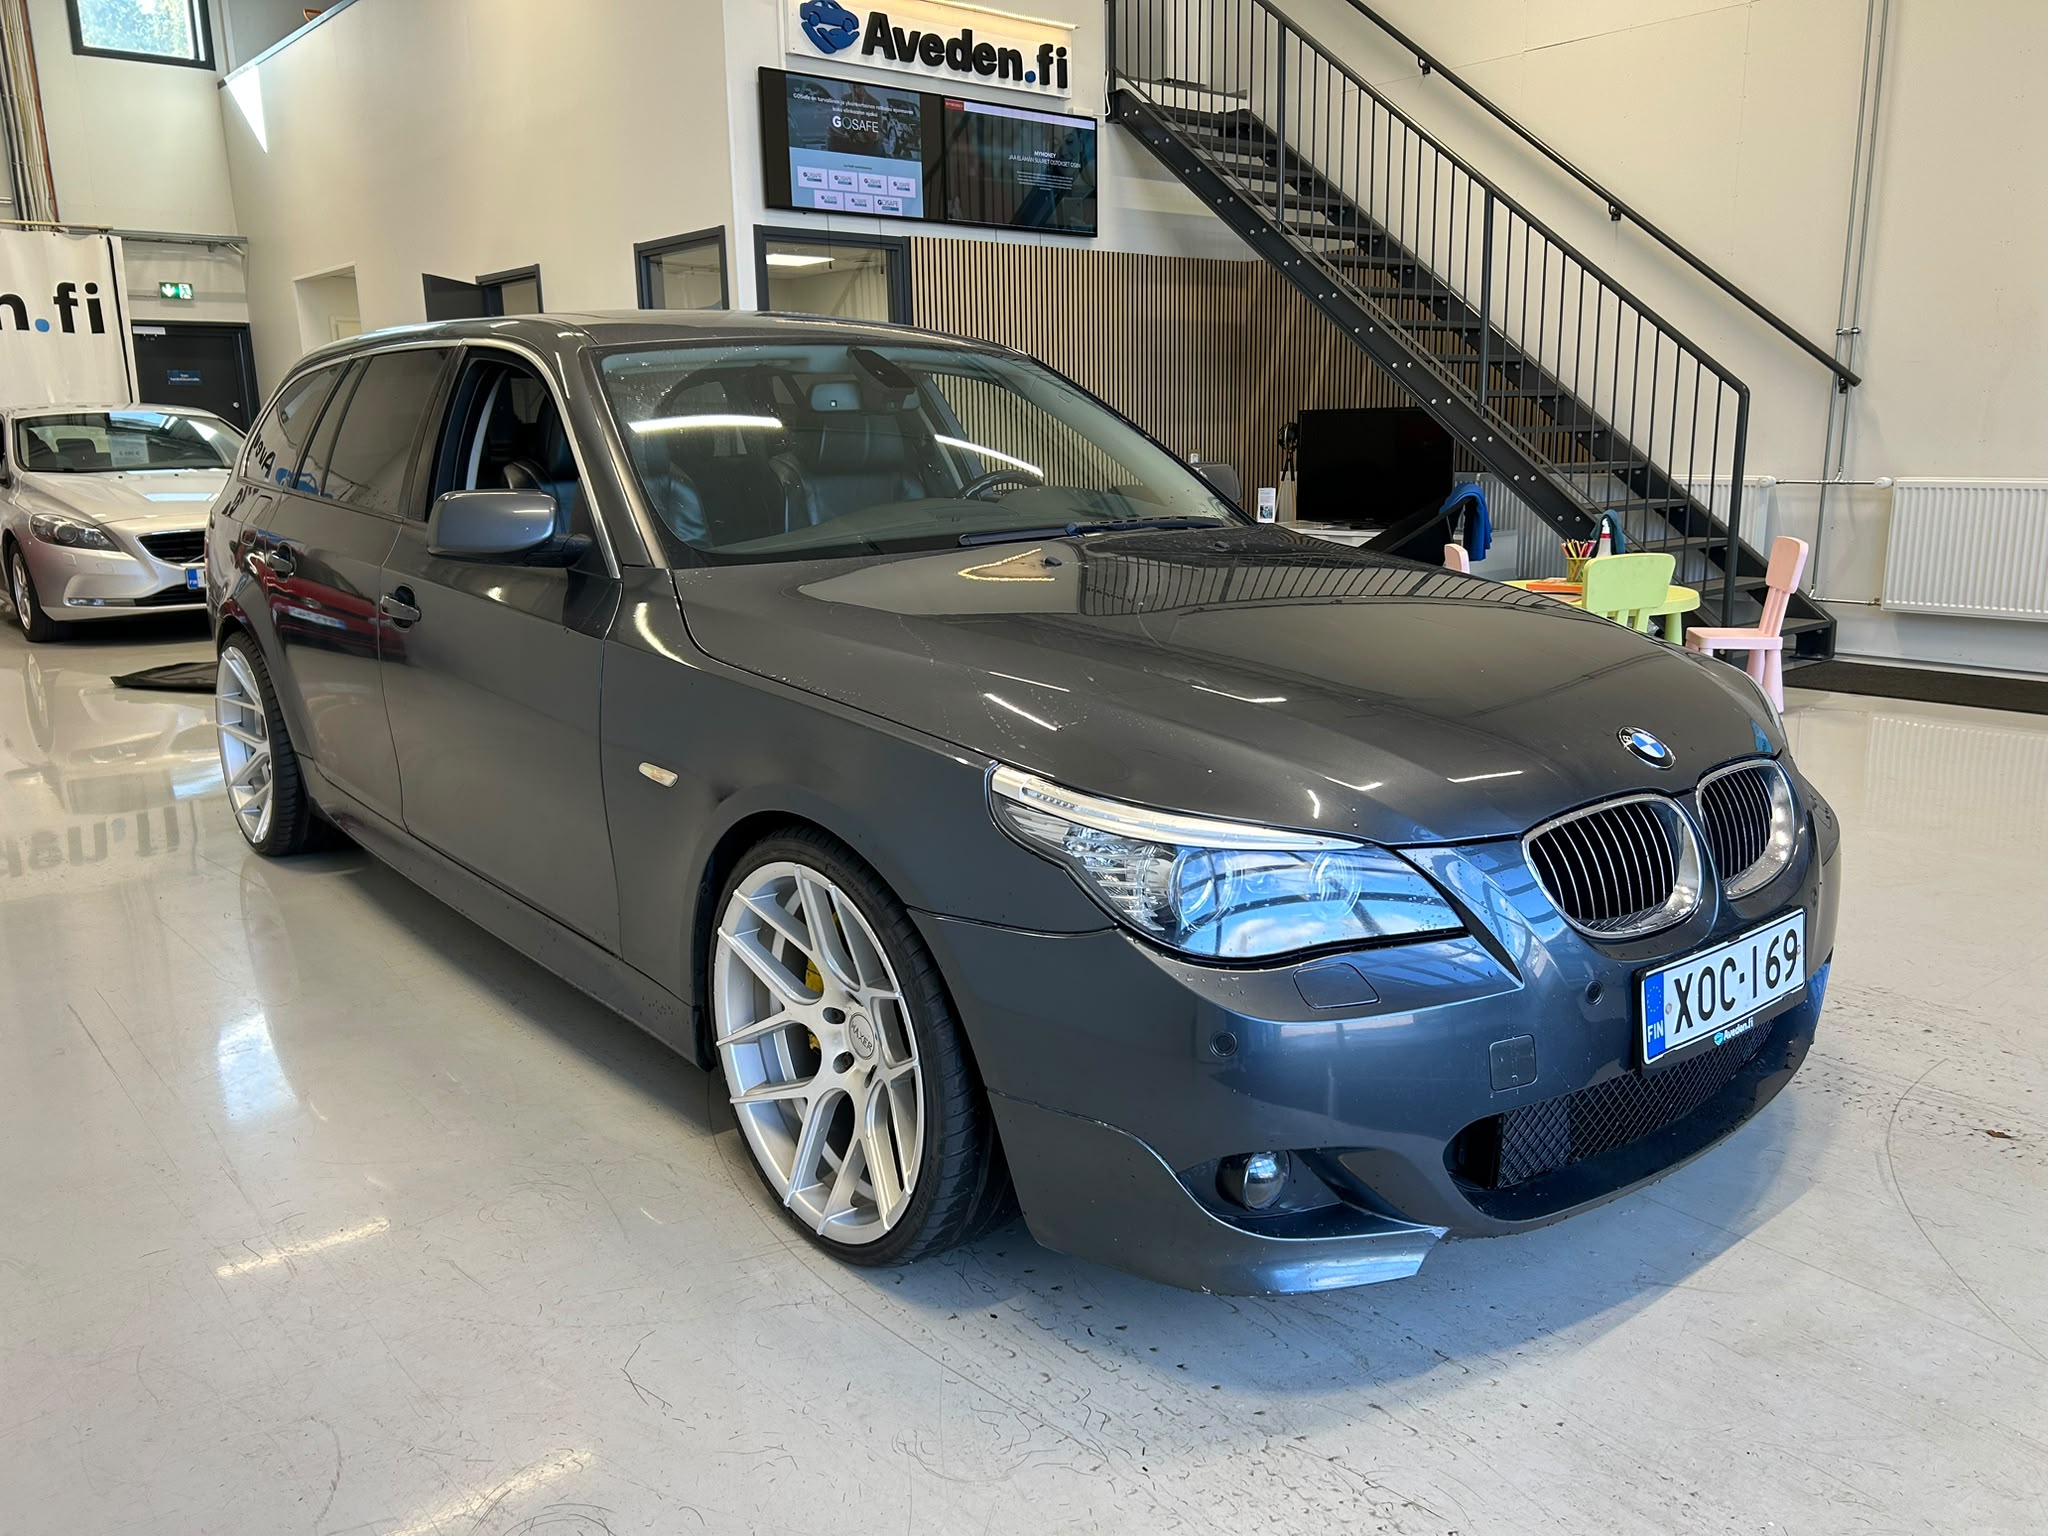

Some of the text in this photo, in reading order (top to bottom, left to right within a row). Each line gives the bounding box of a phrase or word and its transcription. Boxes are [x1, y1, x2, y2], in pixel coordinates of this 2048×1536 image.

[861, 11, 1069, 89] Aveden.fi
[832, 115, 879, 133] GOSAFE
[0, 282, 105, 334] n.fi
[1674, 928, 1798, 1035] XOC-169
[1647, 1020, 1664, 1043] FIN
[1723, 1016, 1754, 1041] Aveden.fi
